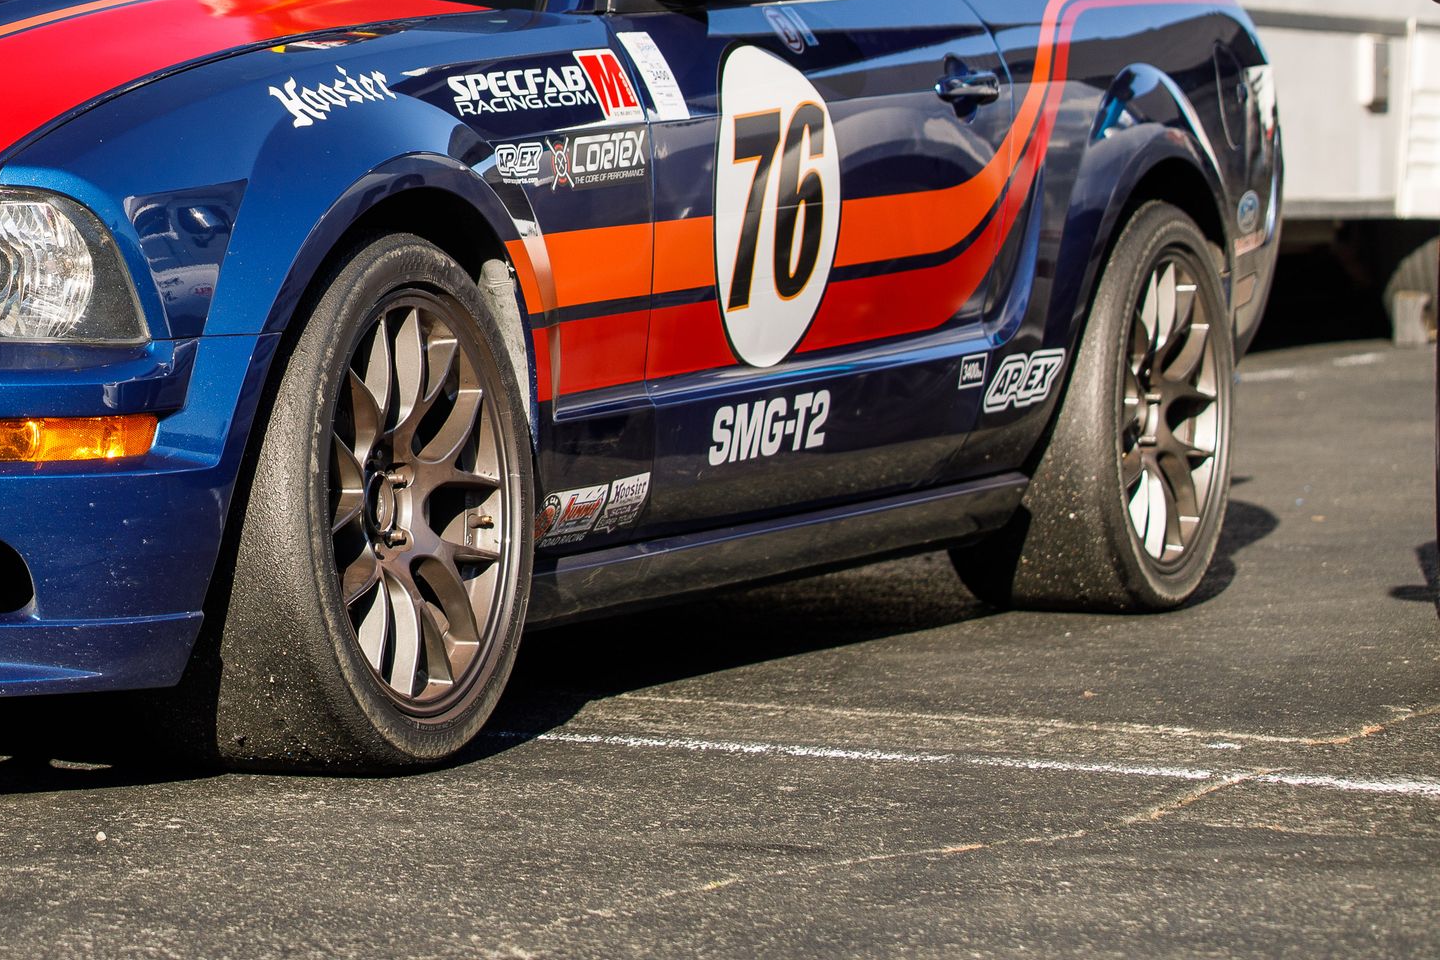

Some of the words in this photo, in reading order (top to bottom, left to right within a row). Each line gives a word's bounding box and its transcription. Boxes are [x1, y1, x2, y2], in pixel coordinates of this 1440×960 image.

[268, 65, 397, 129] Hoosier
[447, 66, 587, 103] SPECFAB
[455, 91, 597, 117] RACING.COM
[574, 176, 585, 184] THE
[585, 174, 599, 183] CORE
[600, 172, 607, 182] OF
[607, 168, 645, 180] PERFORMANCE
[726, 101, 826, 313] 76
[988, 353, 1061, 405] APEX
[708, 389, 831, 467] SMG-T2
[613, 478, 647, 503] Hoosier
